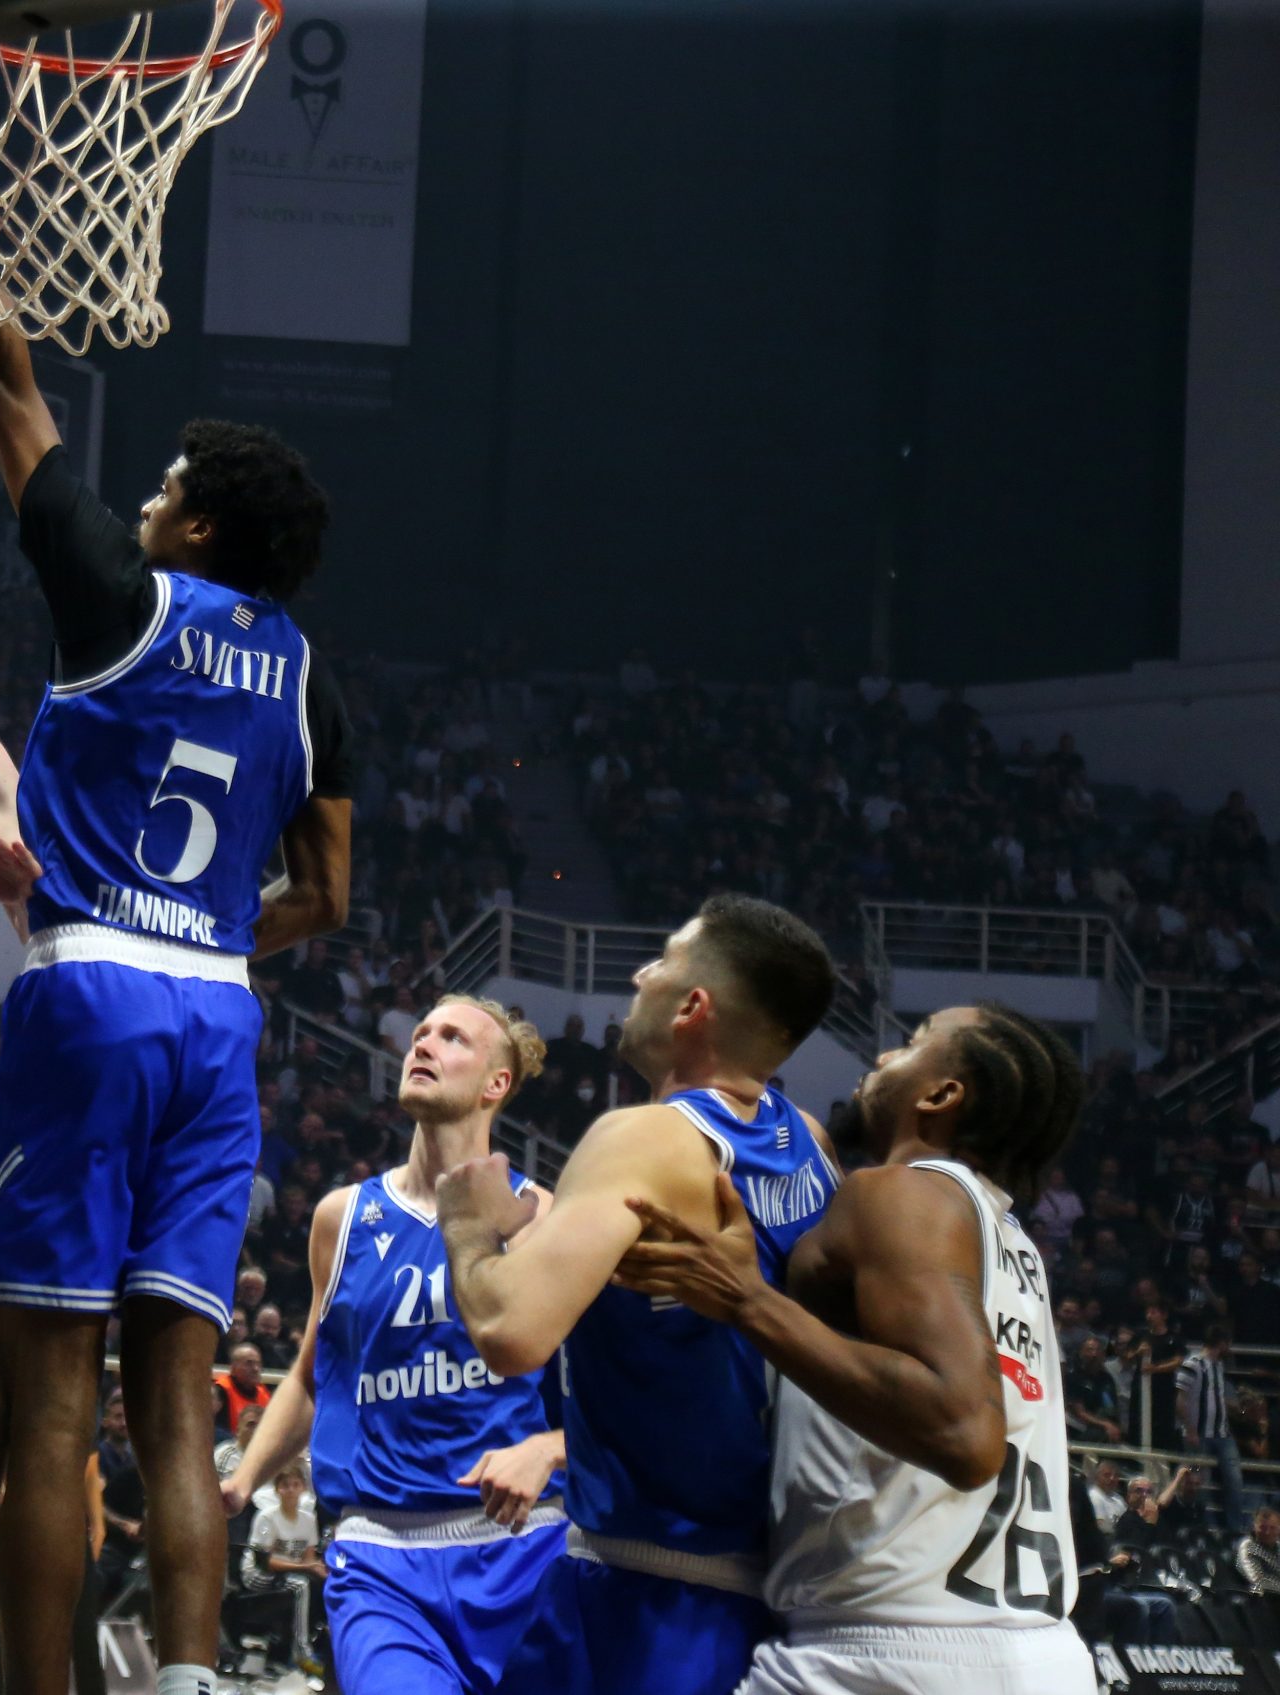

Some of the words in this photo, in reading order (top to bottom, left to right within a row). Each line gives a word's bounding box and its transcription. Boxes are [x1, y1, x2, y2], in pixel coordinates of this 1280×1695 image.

[171, 626, 287, 700] SMITH
[135, 738, 237, 884] 5
[390, 1263, 454, 1328] 21
[945, 1441, 1065, 1621] 26
